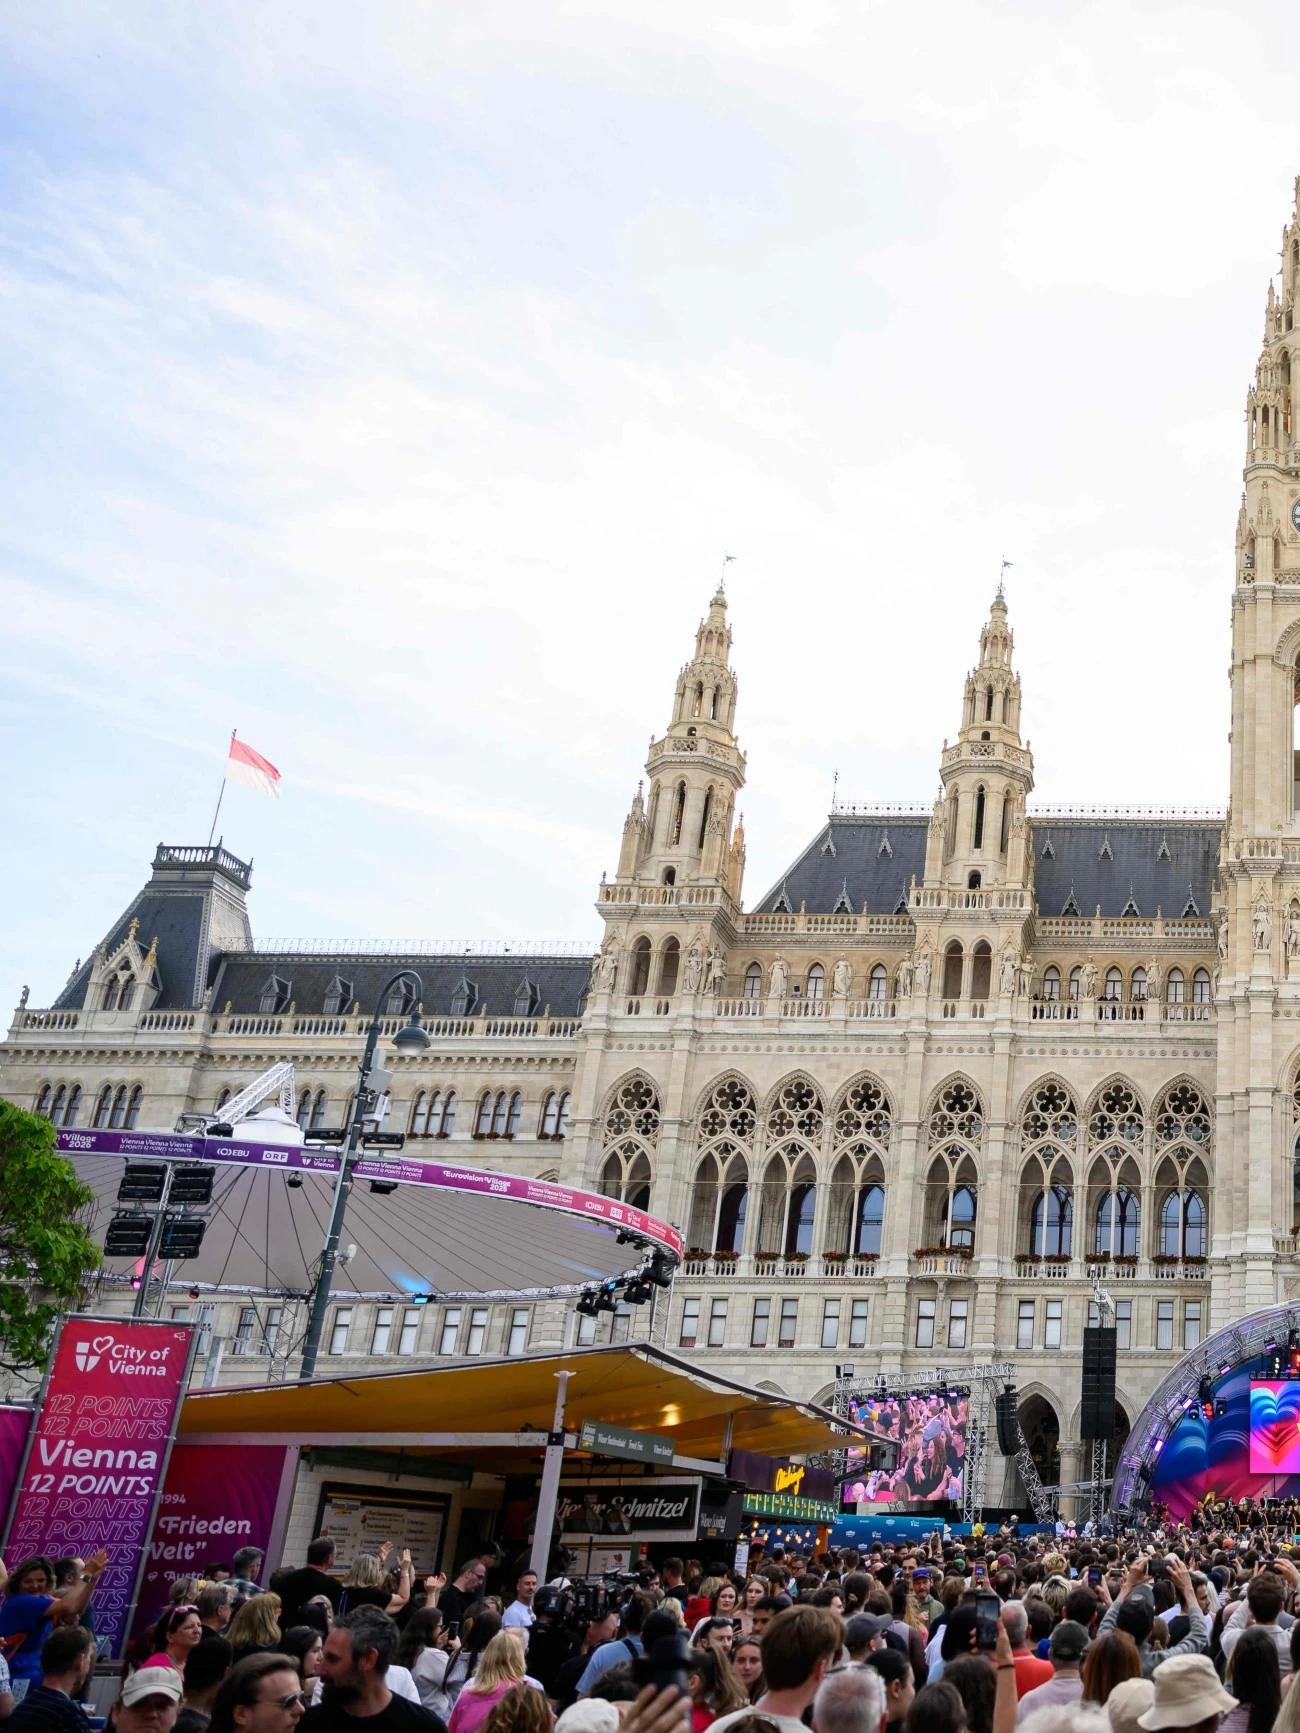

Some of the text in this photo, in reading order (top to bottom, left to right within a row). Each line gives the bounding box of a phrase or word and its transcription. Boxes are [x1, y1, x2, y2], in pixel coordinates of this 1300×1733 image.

[62, 1133, 96, 1142] Village
[69, 1140, 91, 1148] 2026
[145, 1139, 168, 1147] Vienna
[264, 1152, 287, 1161] ORF
[380, 1162, 402, 1170] Vienna
[402, 1165, 423, 1174] Vienna
[443, 1170, 512, 1187] Eurovision Village
[111, 1344, 170, 1363] City of
[108, 1359, 167, 1376] Vienna
[49, 1394, 171, 1418] 12 POINTS
[44, 1416, 166, 1439] 12 POINTS
[39, 1438, 158, 1470] Vienna
[28, 1474, 153, 1496] 12 POINTS
[22, 1496, 148, 1519] 12 POINTS
[16, 1519, 143, 1541] 12 POINTS
[158, 1515, 251, 1535] Frieden
[10, 1542, 38, 1563] 12
